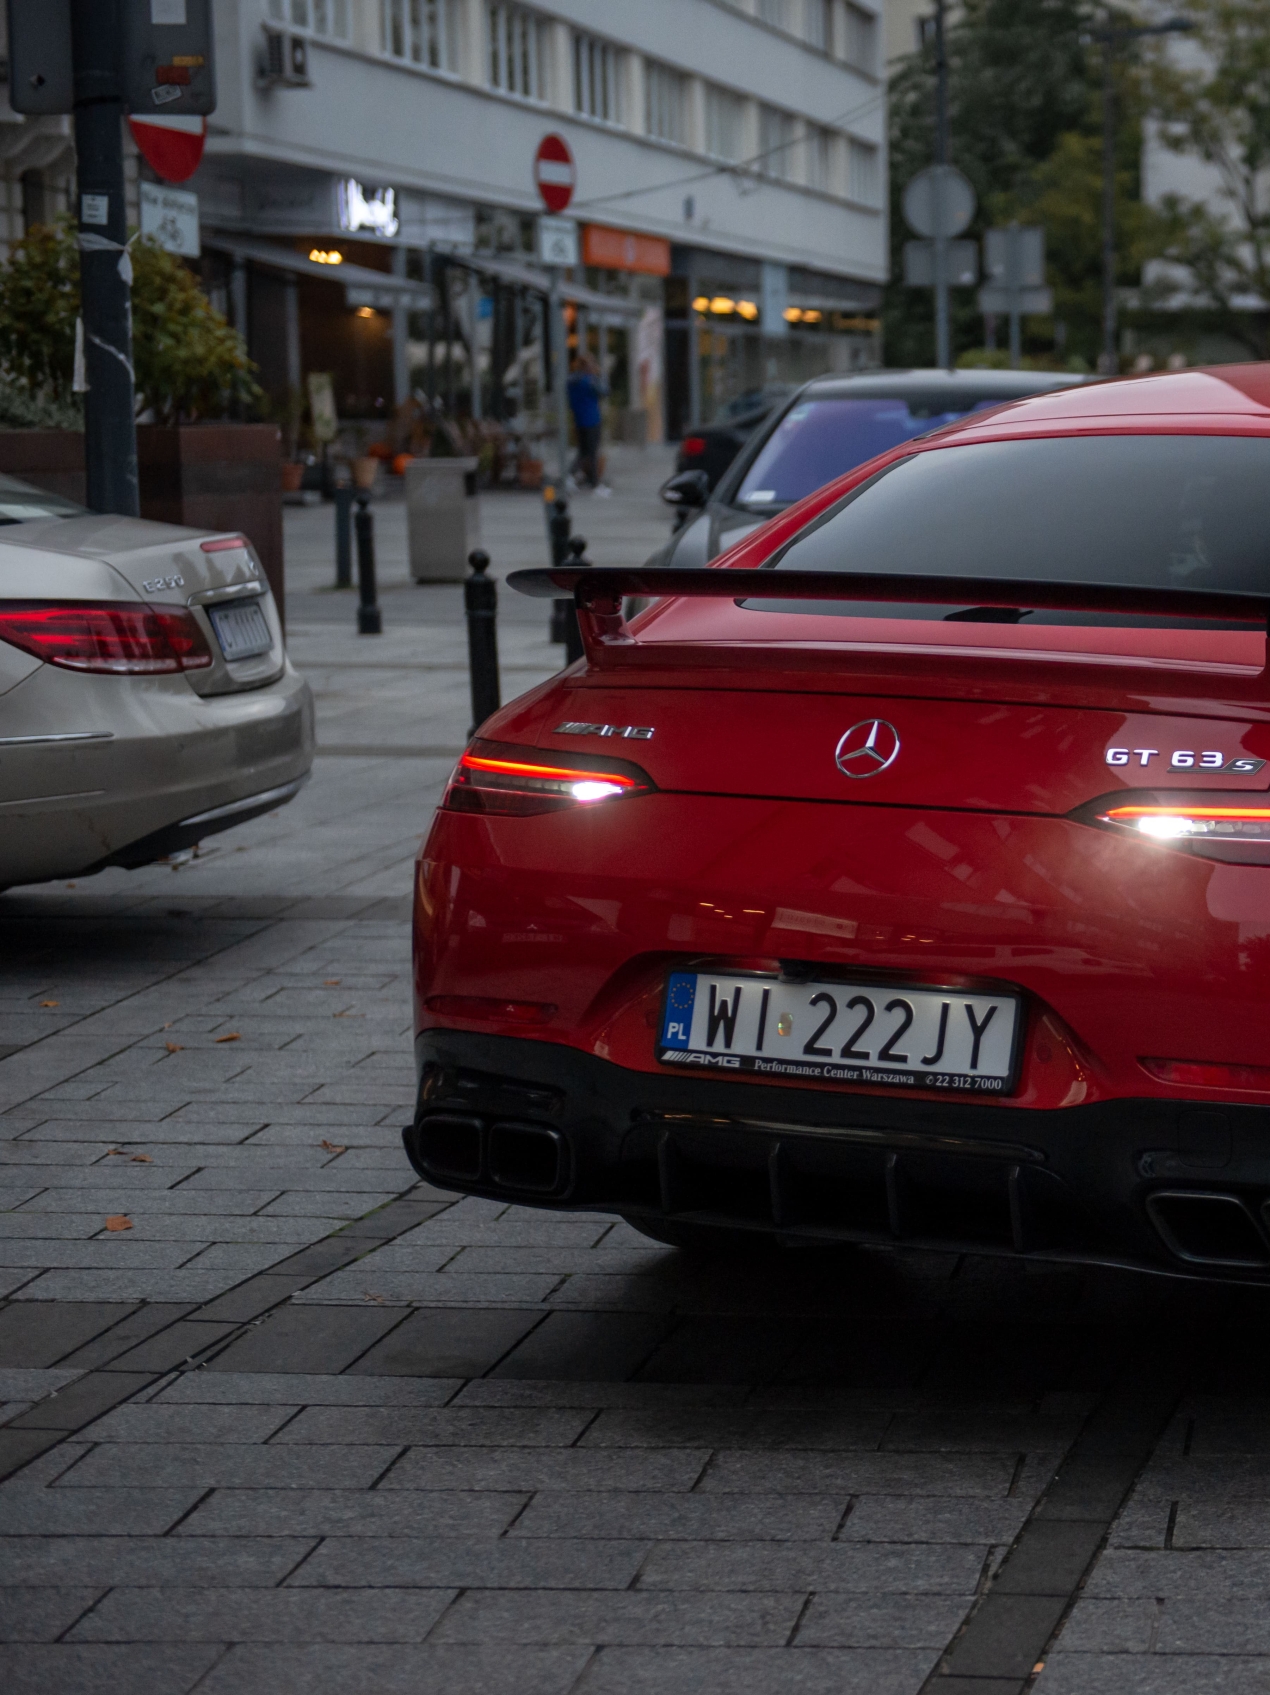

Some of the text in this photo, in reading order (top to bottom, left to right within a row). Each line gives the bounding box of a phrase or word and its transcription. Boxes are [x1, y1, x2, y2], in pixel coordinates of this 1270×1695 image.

[1105, 747, 1160, 767] GT
[1170, 750, 1225, 768] 63
[666, 1022, 687, 1040] PL
[705, 983, 999, 1071] WI 222JY
[754, 1059, 821, 1076] Performance
[823, 1065, 860, 1080] Center
[862, 1068, 915, 1085] Warszawa
[935, 1075, 949, 1087] 22
[952, 1076, 971, 1088] 312
[974, 1077, 1002, 1090] 7000
